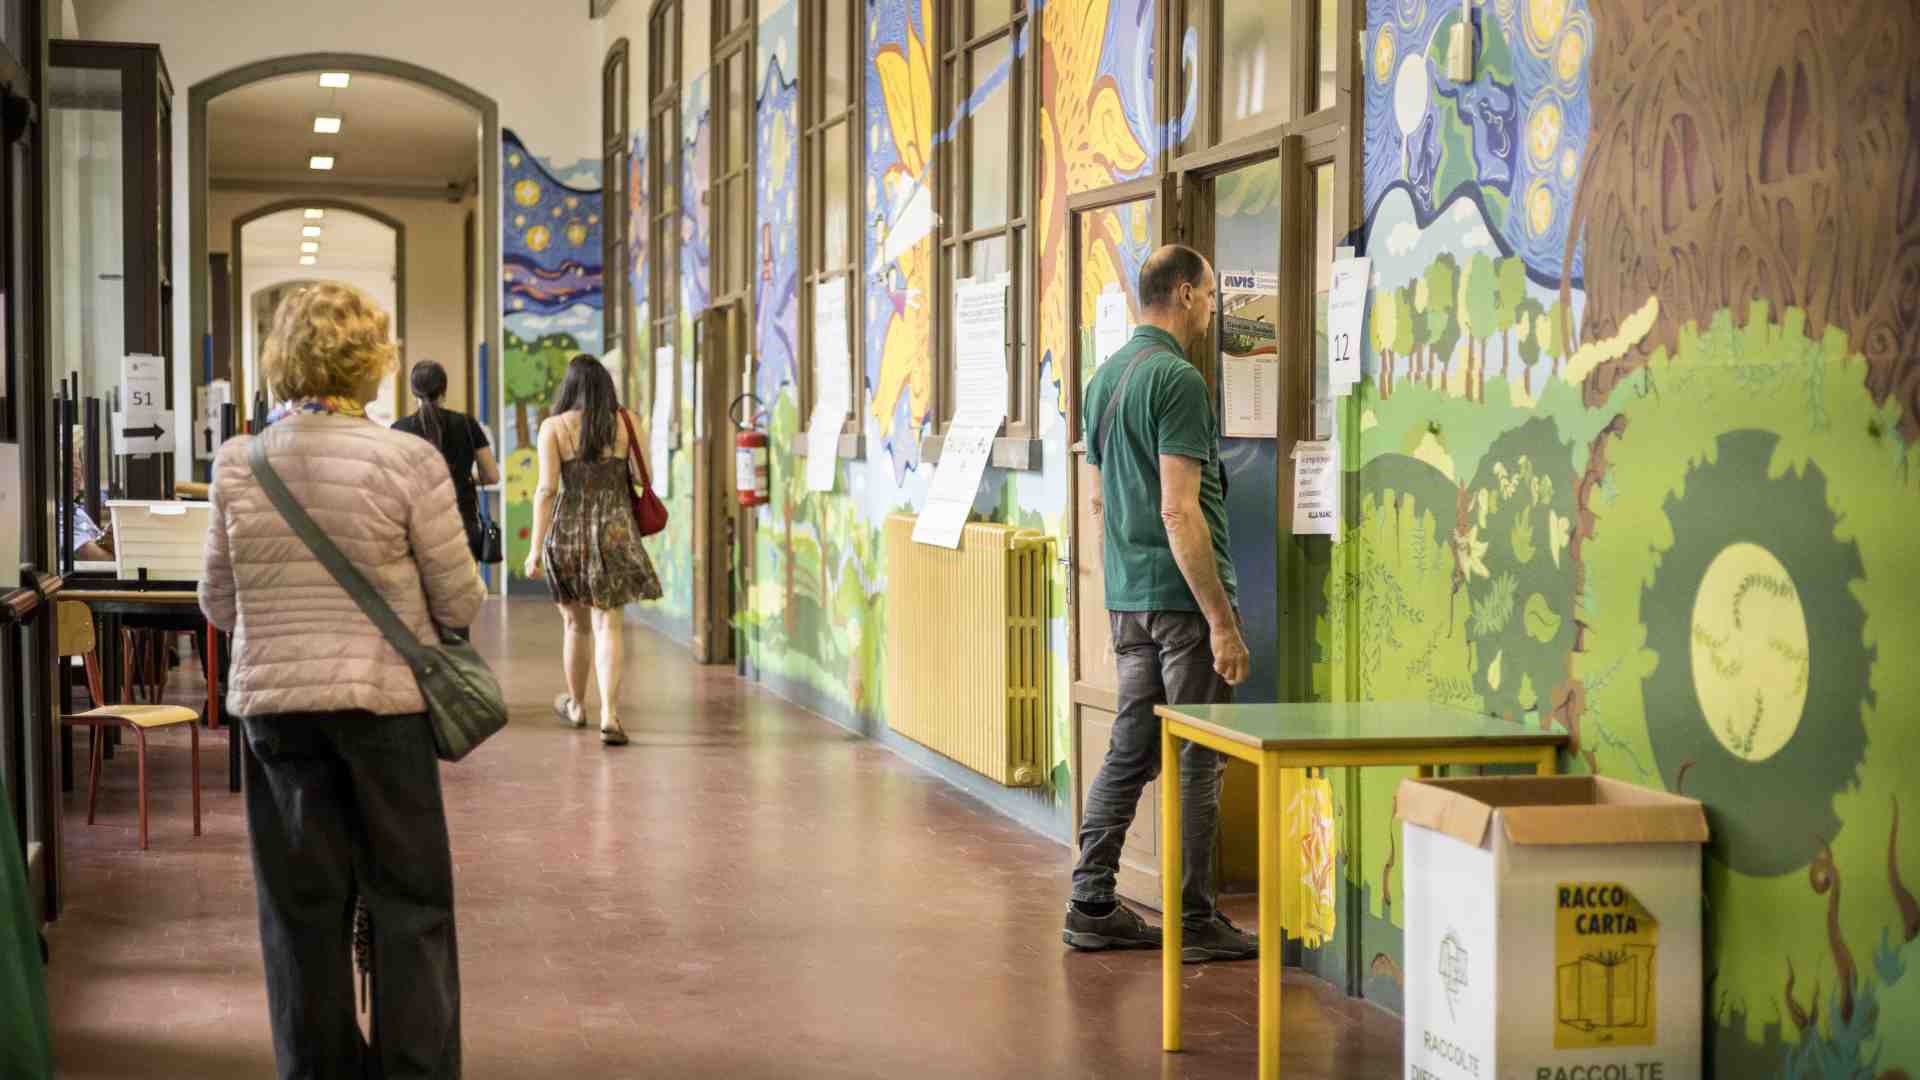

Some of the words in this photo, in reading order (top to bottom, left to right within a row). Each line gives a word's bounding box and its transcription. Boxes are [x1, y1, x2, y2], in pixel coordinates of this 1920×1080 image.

[1224, 276, 1255, 288] AVIS
[1334, 332, 1350, 362] 12
[133, 391, 152, 406] 51
[1575, 913, 1638, 935] CARTA
[1424, 1030, 1480, 1078] RACCOLTE
[1536, 1062, 1665, 1080] RACCOLTE
